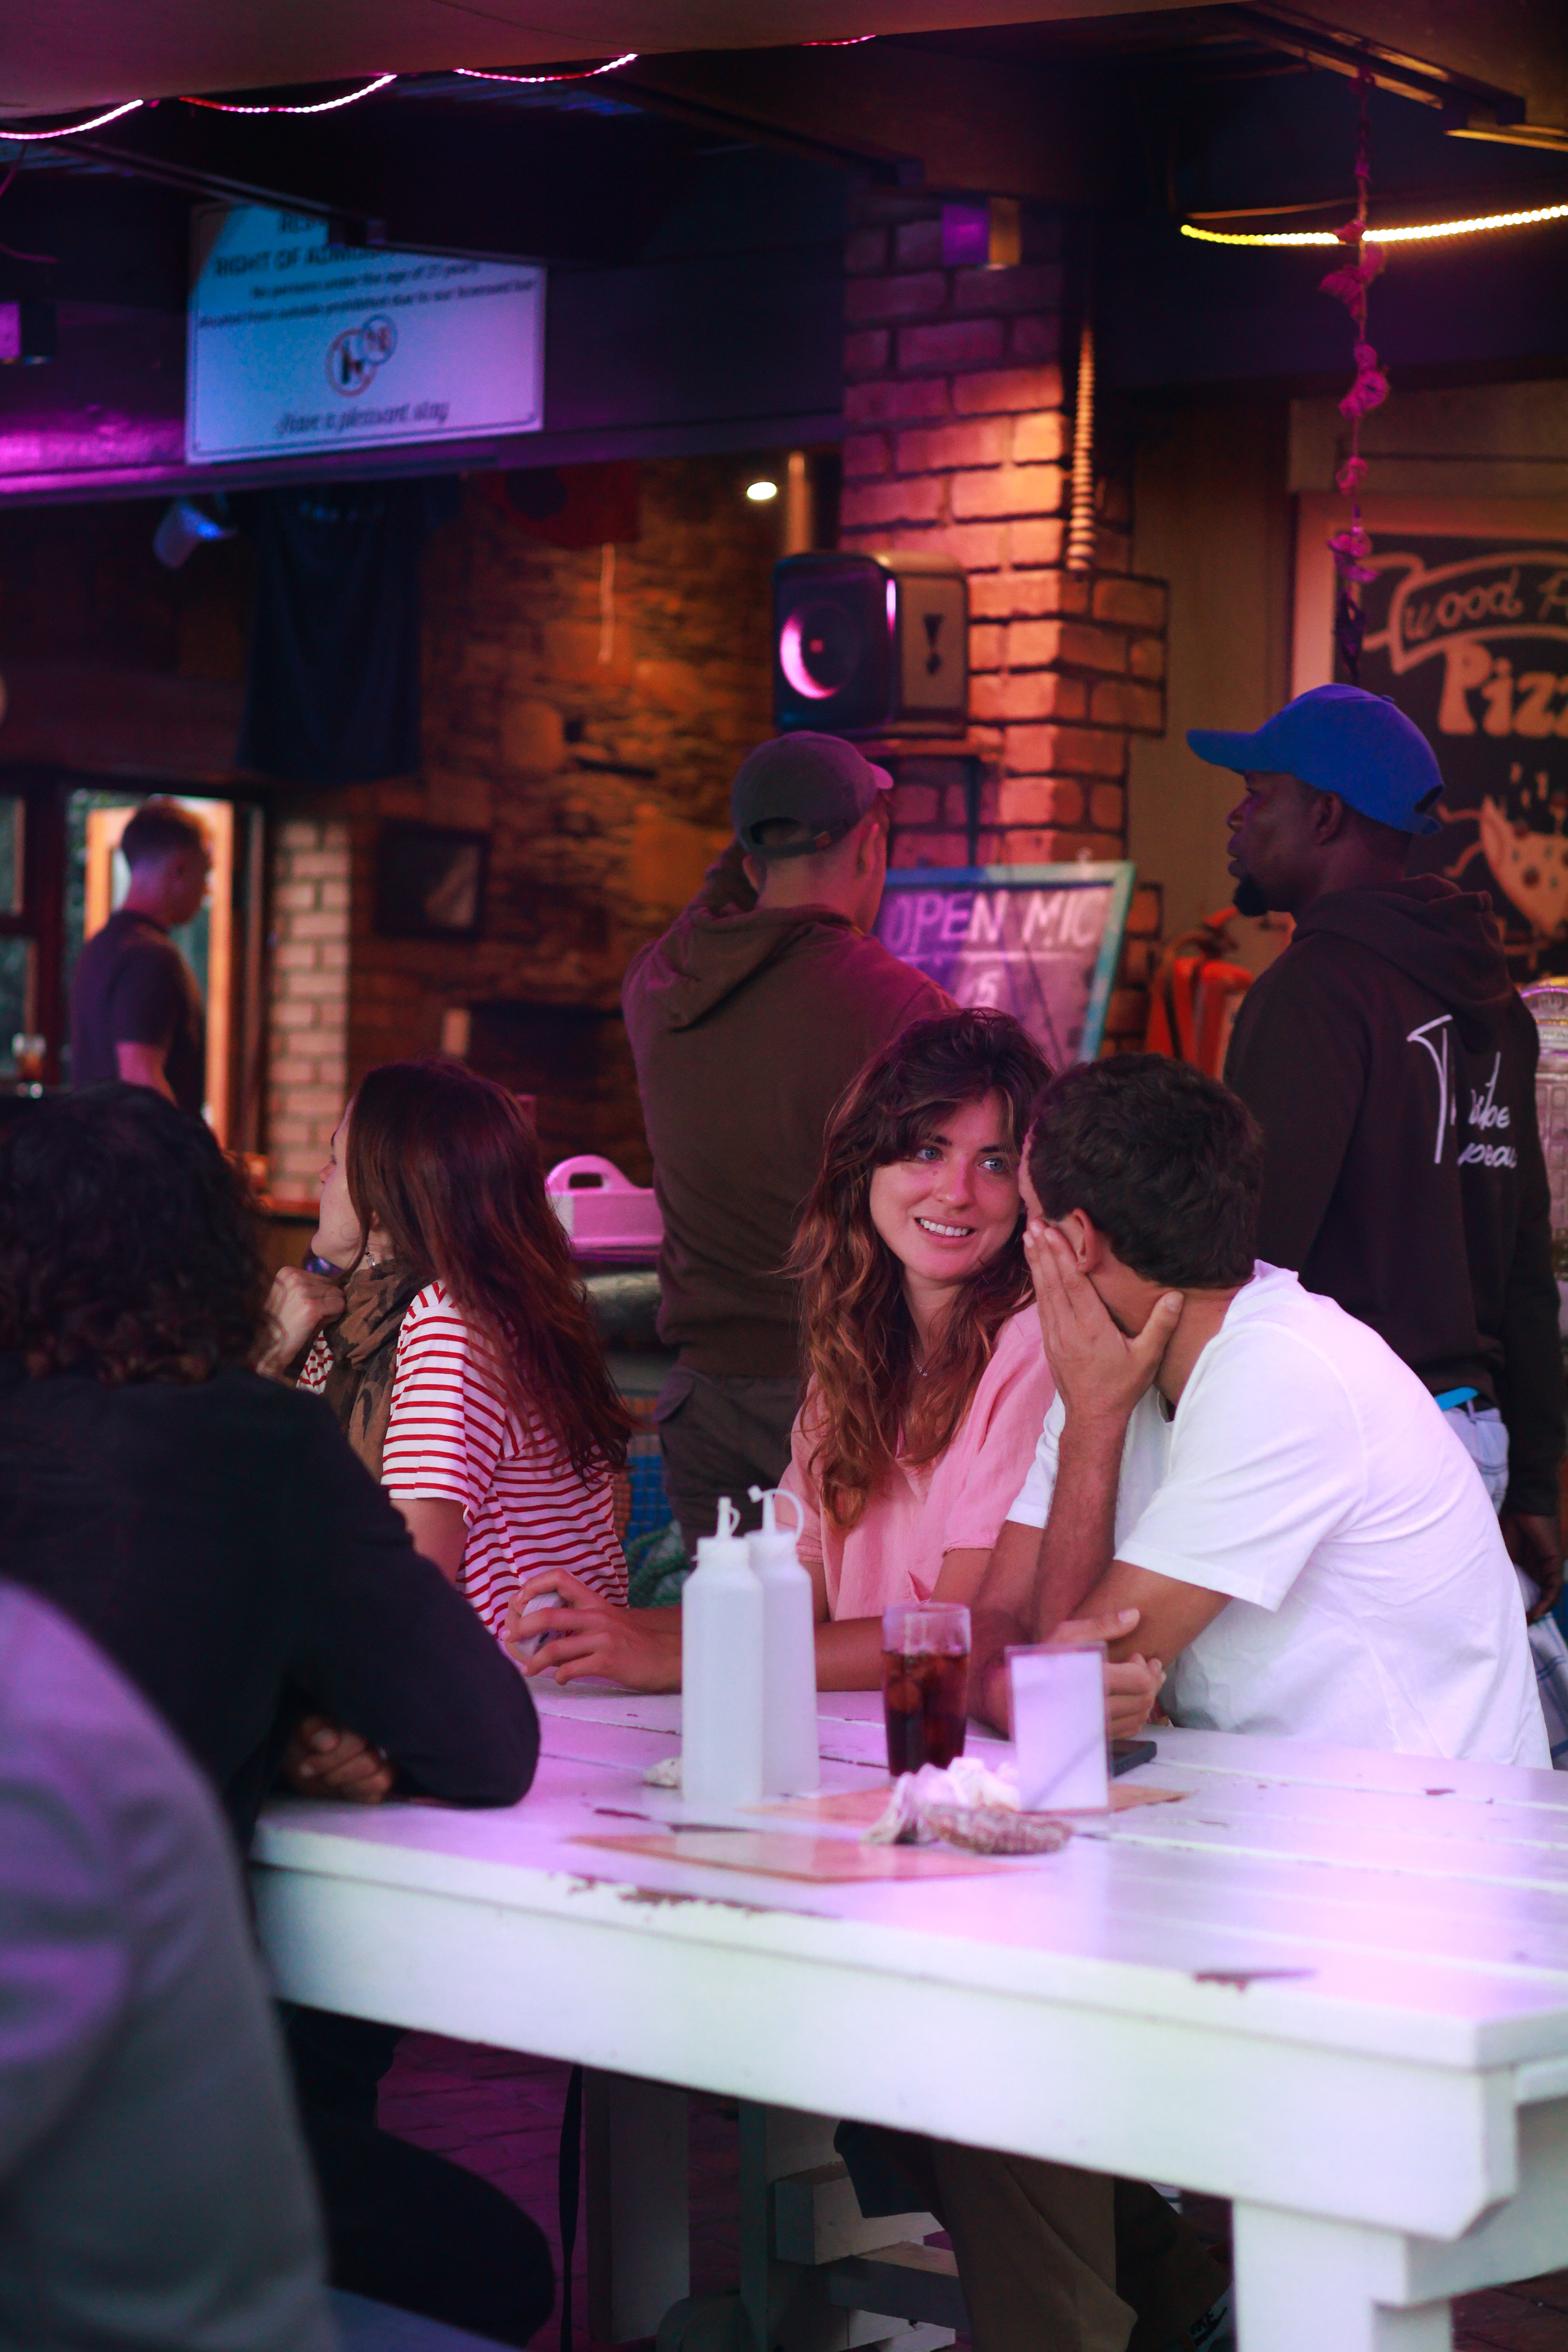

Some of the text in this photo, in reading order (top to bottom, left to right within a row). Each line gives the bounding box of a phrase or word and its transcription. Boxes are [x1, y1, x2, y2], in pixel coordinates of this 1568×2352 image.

[274, 247, 298, 271] OF
[879, 888, 1109, 954] OPEN MIC
